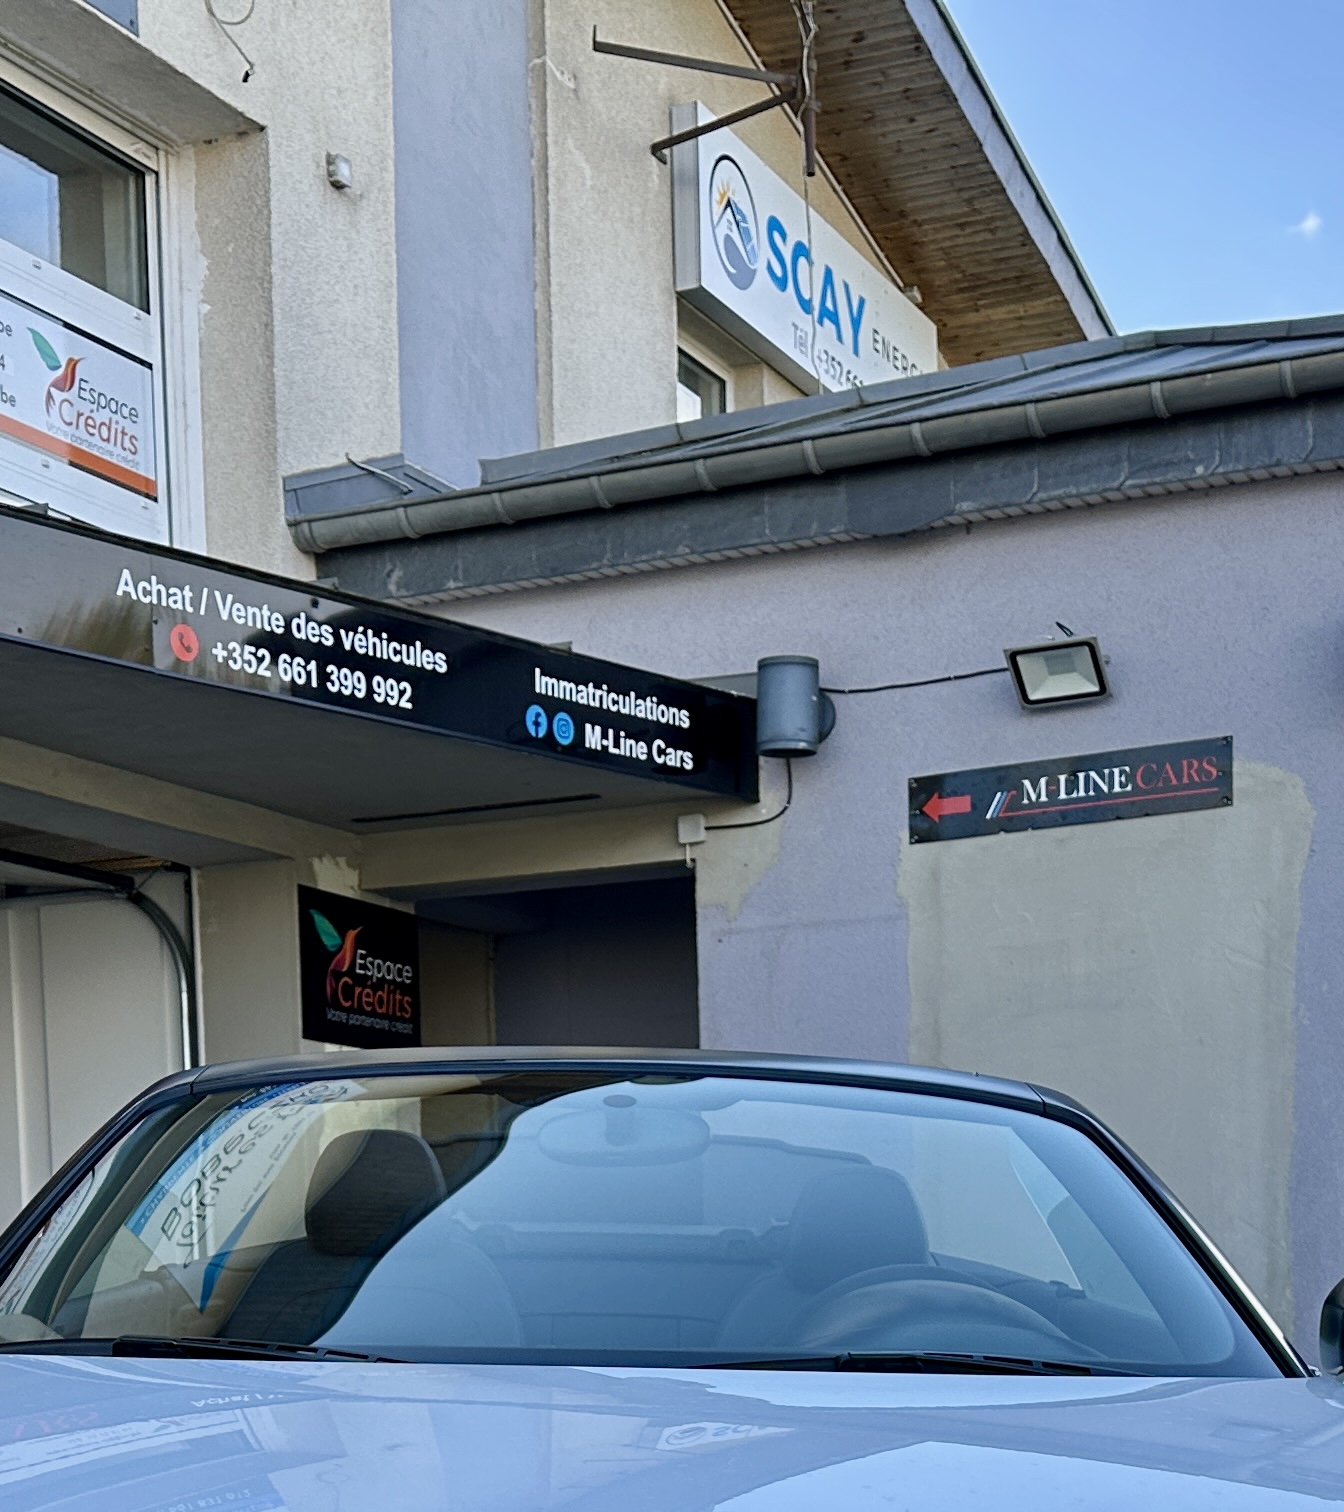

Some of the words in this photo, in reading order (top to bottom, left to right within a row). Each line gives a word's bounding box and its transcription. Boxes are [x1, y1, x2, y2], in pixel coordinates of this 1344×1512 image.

[766, 214, 866, 359] SCAY
[871, 328, 924, 378] ENER
[77, 378, 139, 424] Espace
[58, 398, 138, 456] Crédits
[116, 568, 194, 616] Achat
[215, 591, 285, 636] Vente
[291, 610, 334, 647] des
[340, 621, 447, 674] véhicules
[211, 639, 272, 678] +352
[278, 657, 318, 688] 661
[326, 666, 367, 700] 399
[372, 677, 413, 710] 992
[534, 668, 690, 729] Immatriculations
[584, 724, 648, 762] M-Line
[652, 739, 693, 771] Cars
[1021, 766, 1133, 805] M-LINE
[1136, 756, 1218, 790] CARS
[355, 949, 413, 984] Espace
[338, 976, 412, 1019] Crédits
